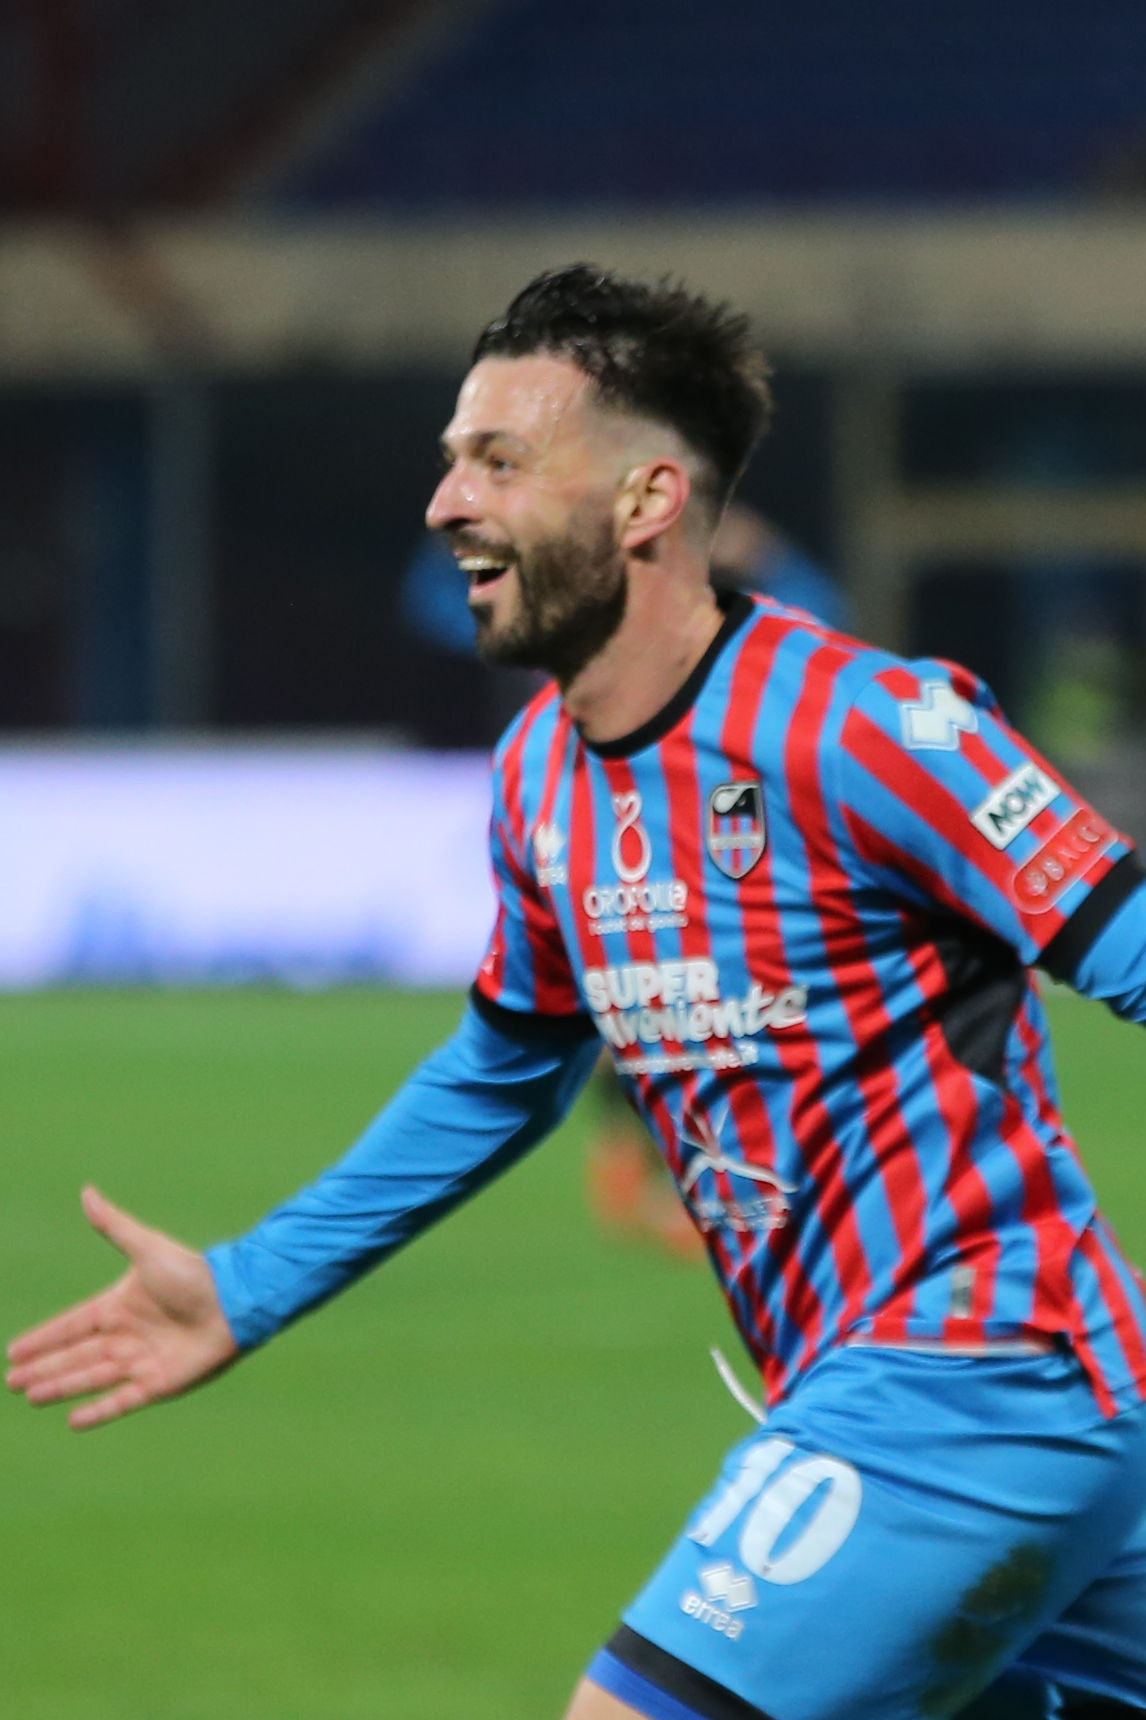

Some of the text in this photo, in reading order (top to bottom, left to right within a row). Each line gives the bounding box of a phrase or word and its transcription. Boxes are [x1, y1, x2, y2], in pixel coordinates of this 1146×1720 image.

[987, 772, 1046, 835] NOW
[583, 958, 720, 1012] SUPER
[687, 1434, 863, 1586] 10
